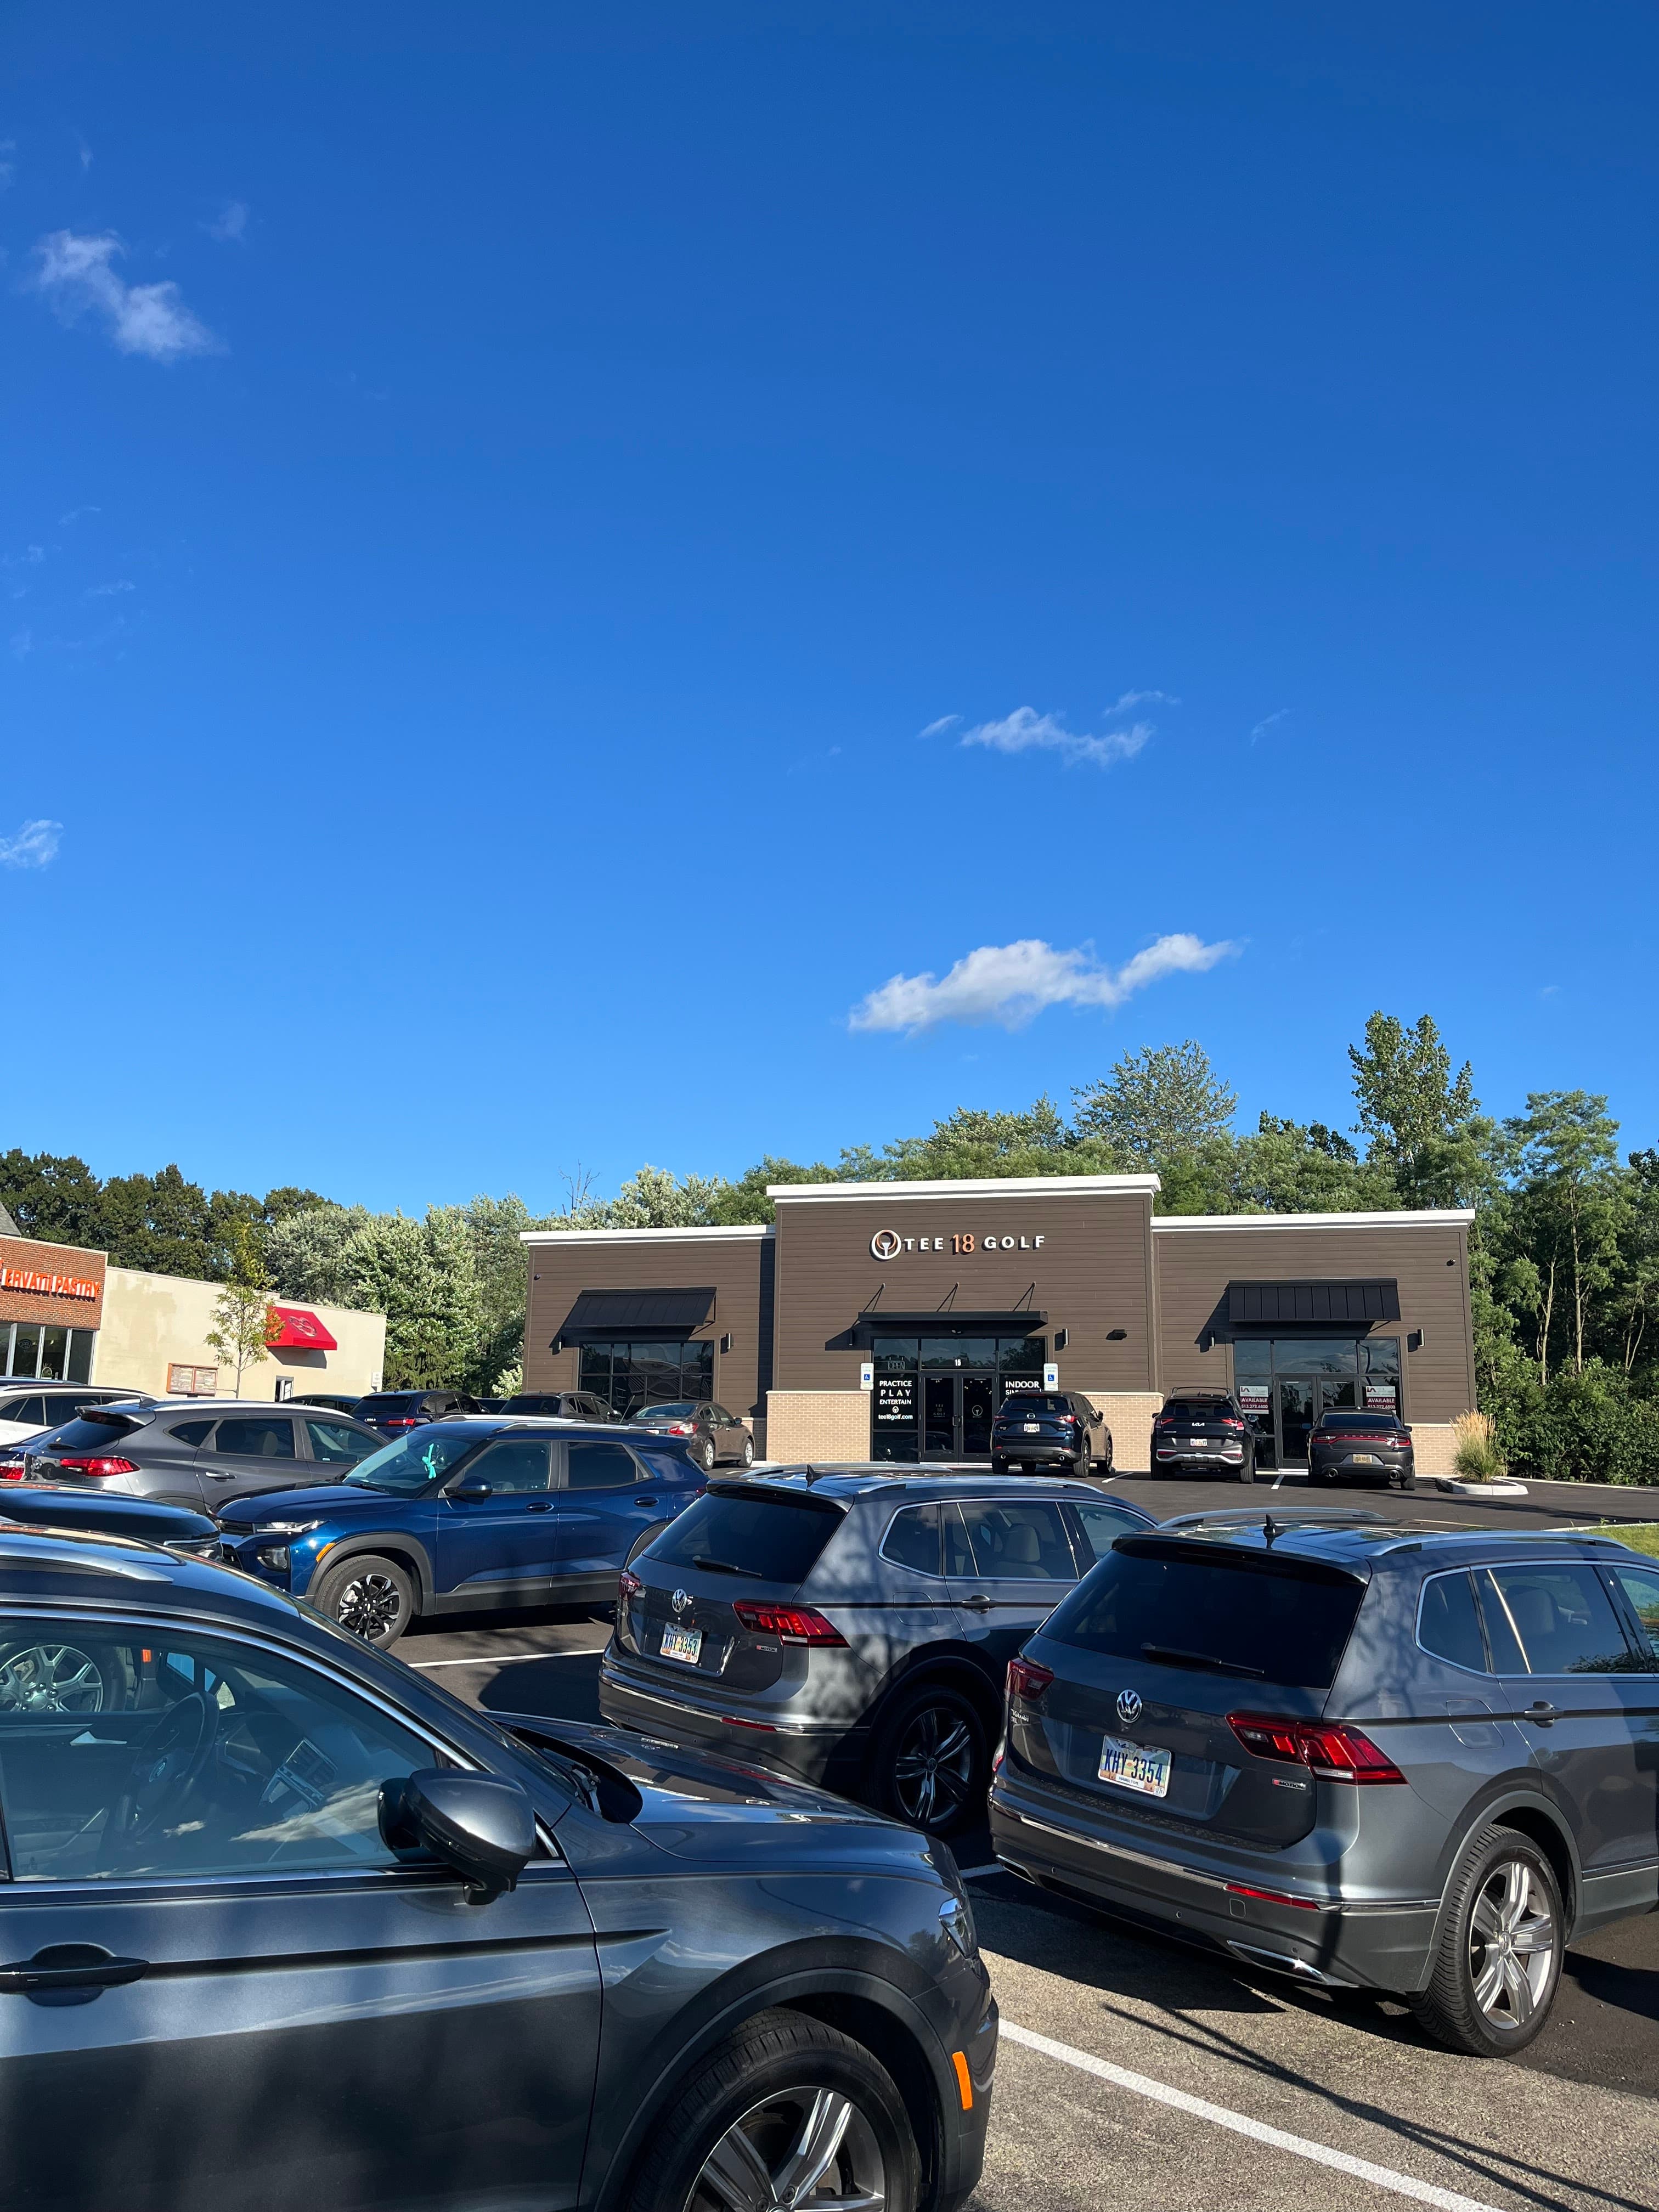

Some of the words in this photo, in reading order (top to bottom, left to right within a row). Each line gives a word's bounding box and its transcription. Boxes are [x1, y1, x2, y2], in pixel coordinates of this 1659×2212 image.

[904, 1238, 944, 1250] TEE
[952, 1234, 975, 1252] 18
[984, 1235, 1045, 1249] GOLF
[55, 1276, 100, 1298] PASTRY
[888, 1361, 905, 1370] OPEN
[664, 1632, 679, 1651] KHY
[679, 1636, 697, 1656] 3353
[1104, 1748, 1128, 1775] KHY
[1131, 1756, 1163, 1786] 3354
